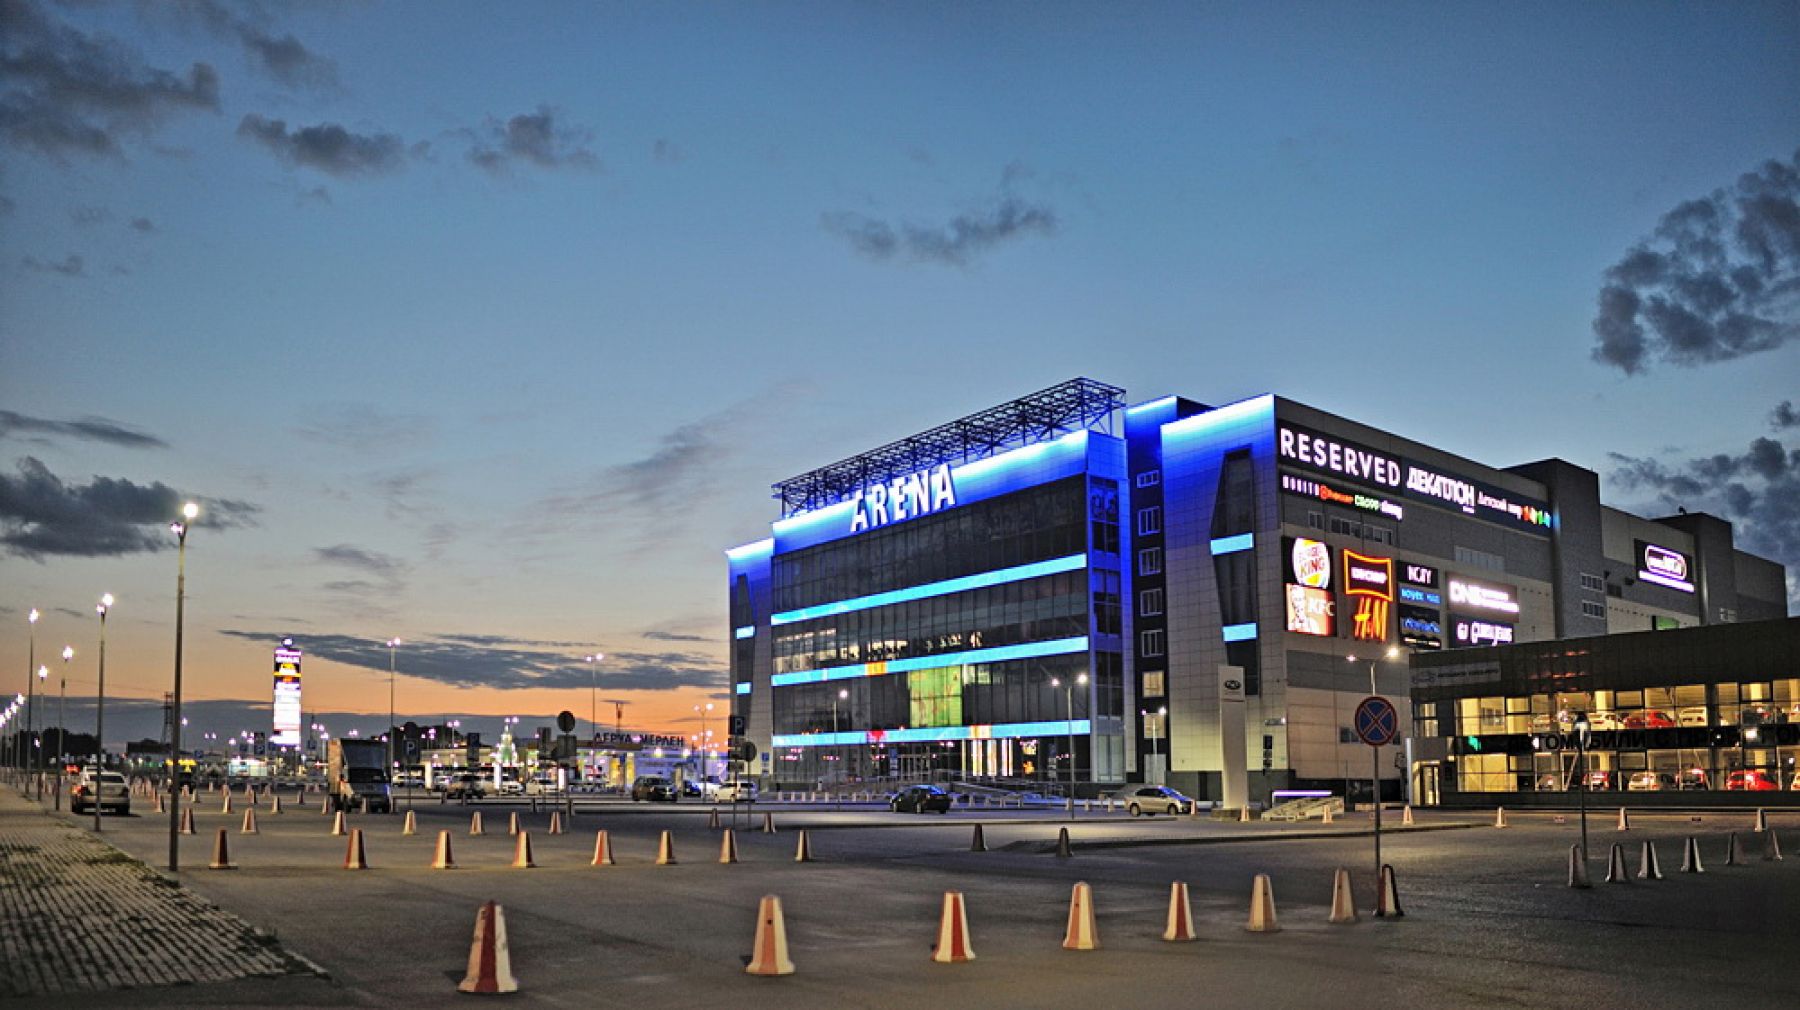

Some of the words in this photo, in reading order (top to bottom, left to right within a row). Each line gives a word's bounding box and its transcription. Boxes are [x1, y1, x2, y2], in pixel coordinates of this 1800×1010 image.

[1281, 428, 1401, 486] RESERVED
[850, 463, 956, 532] ARENA
[1407, 466, 1475, 506] ДЕКАТЛОН
[1354, 597, 1388, 641] H&M
